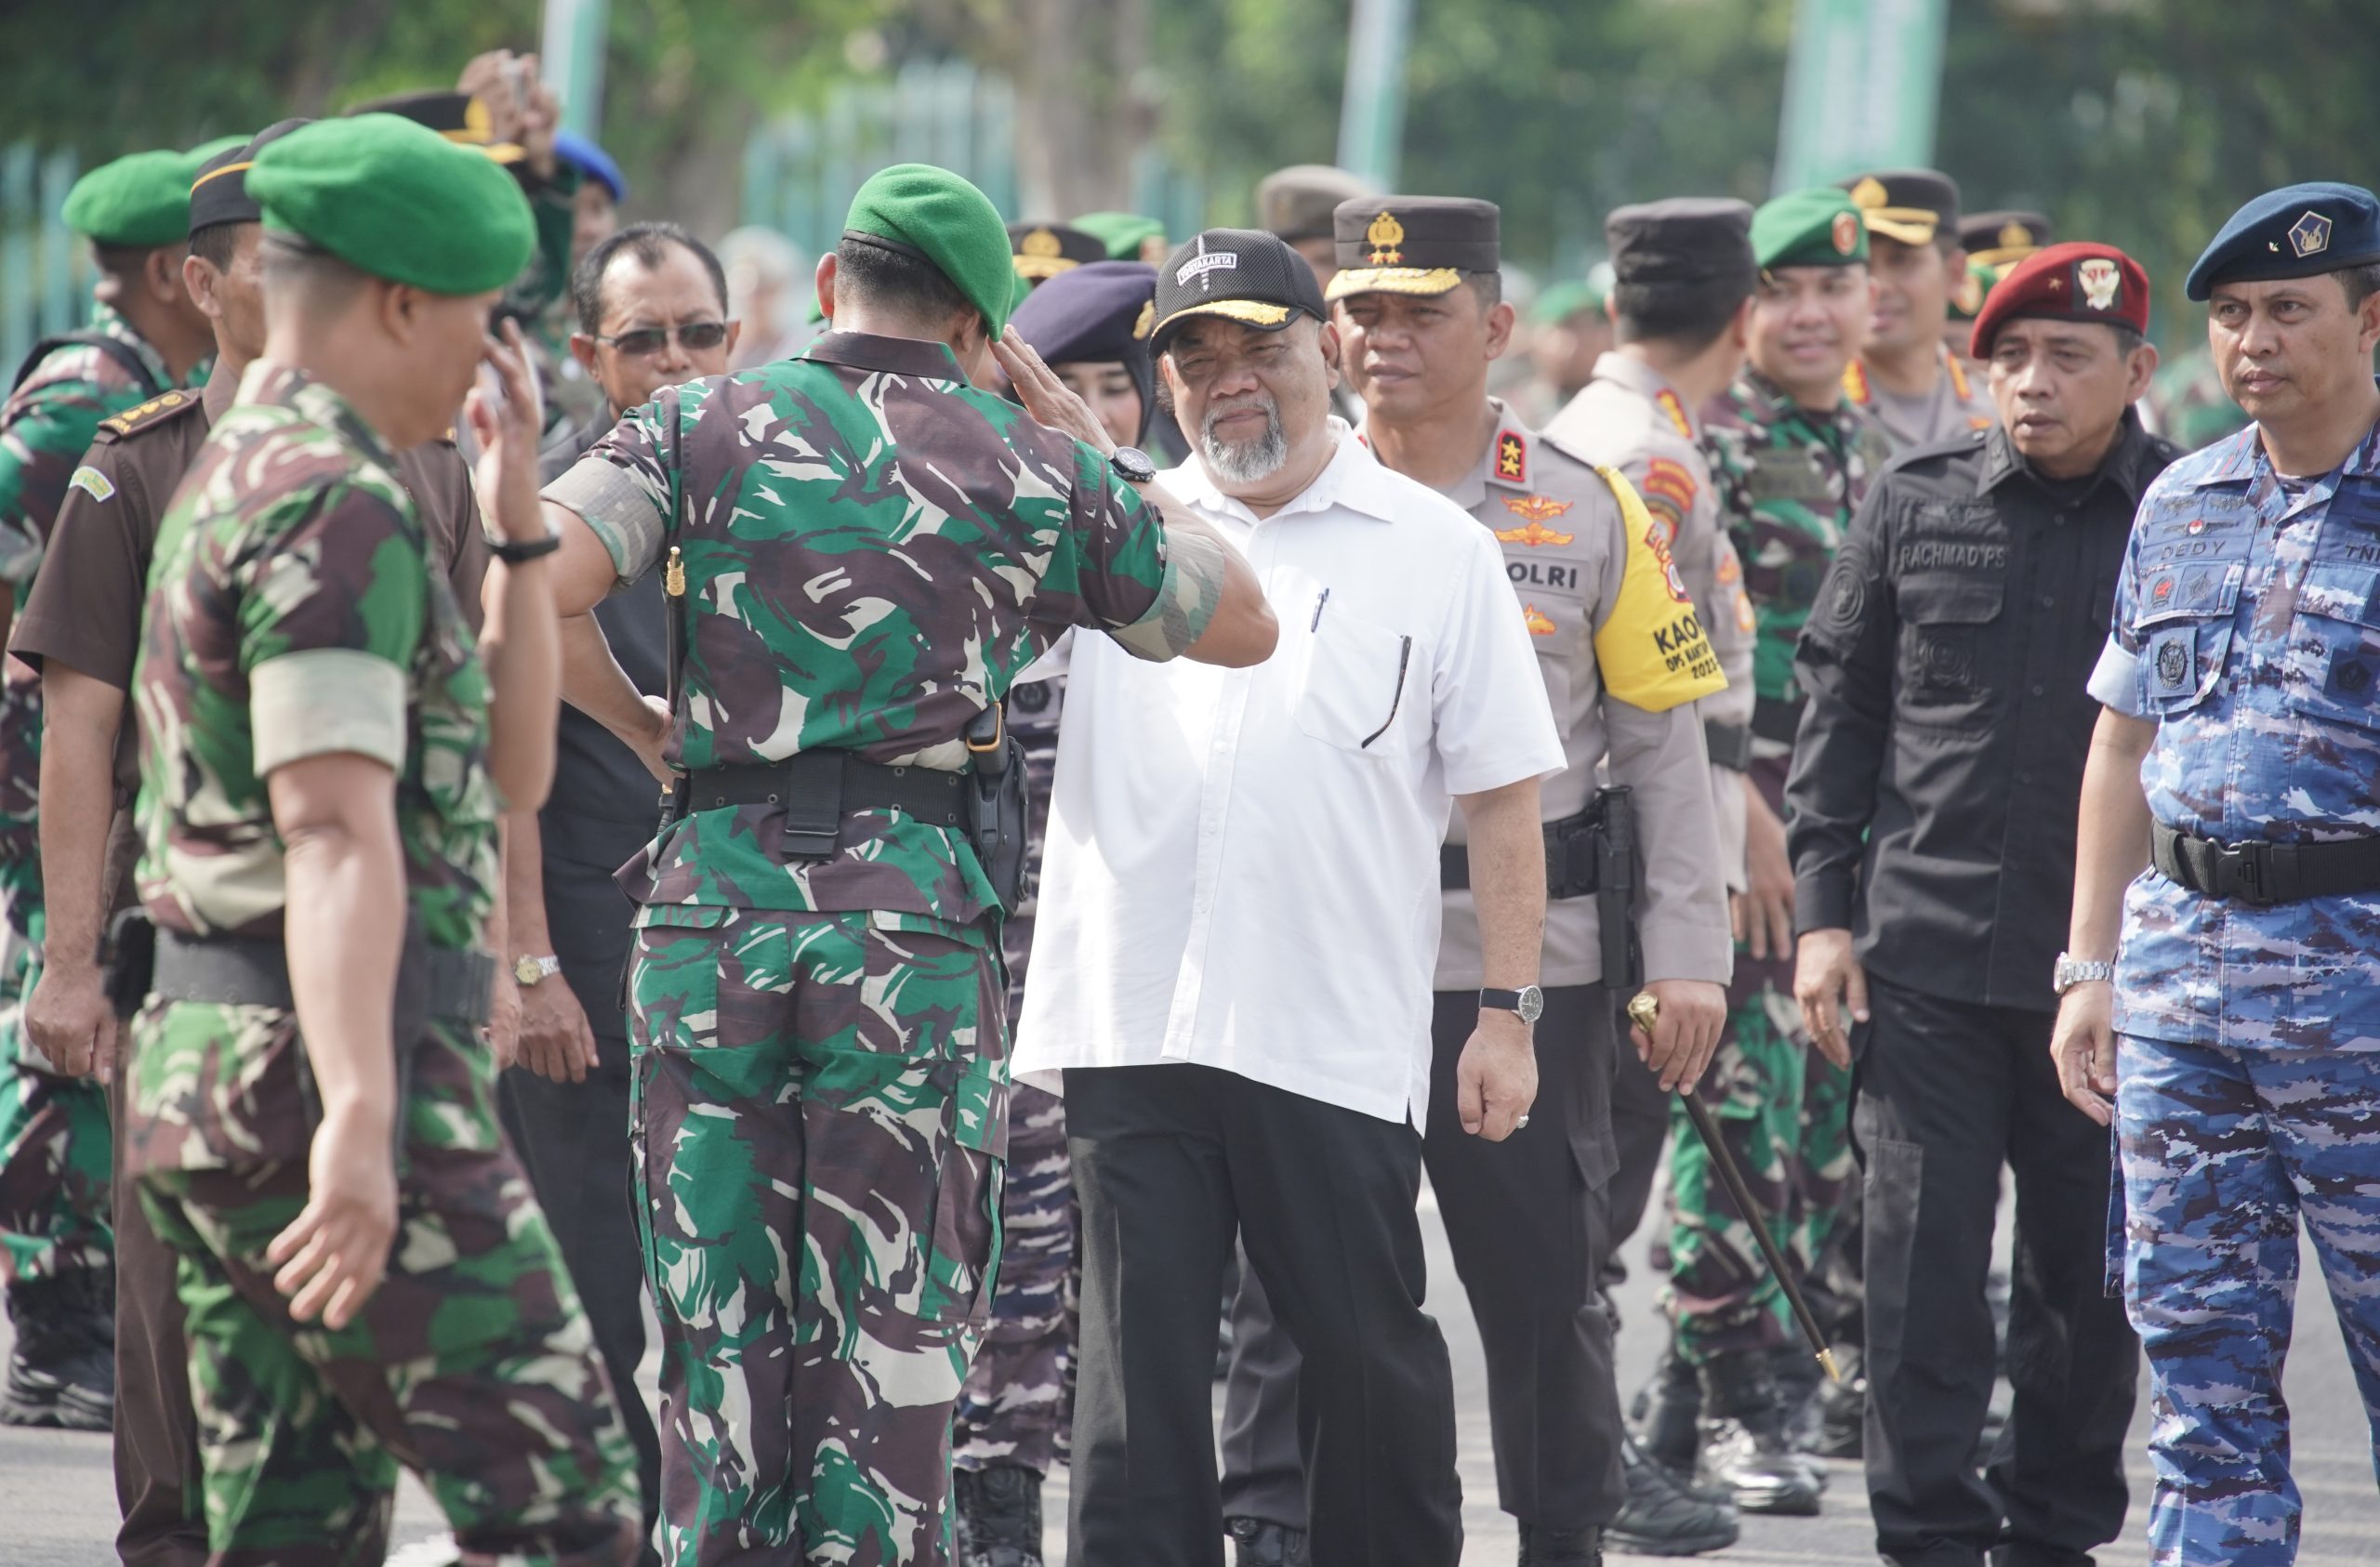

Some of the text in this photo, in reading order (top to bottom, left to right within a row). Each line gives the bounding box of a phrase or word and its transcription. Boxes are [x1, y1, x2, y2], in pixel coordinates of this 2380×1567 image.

[1180, 256, 1232, 279] YOGYAKARTA
[1899, 541, 1979, 568] RACHMAD
[2161, 540, 2226, 560] DEDY
[1665, 653, 1686, 672] OPS
